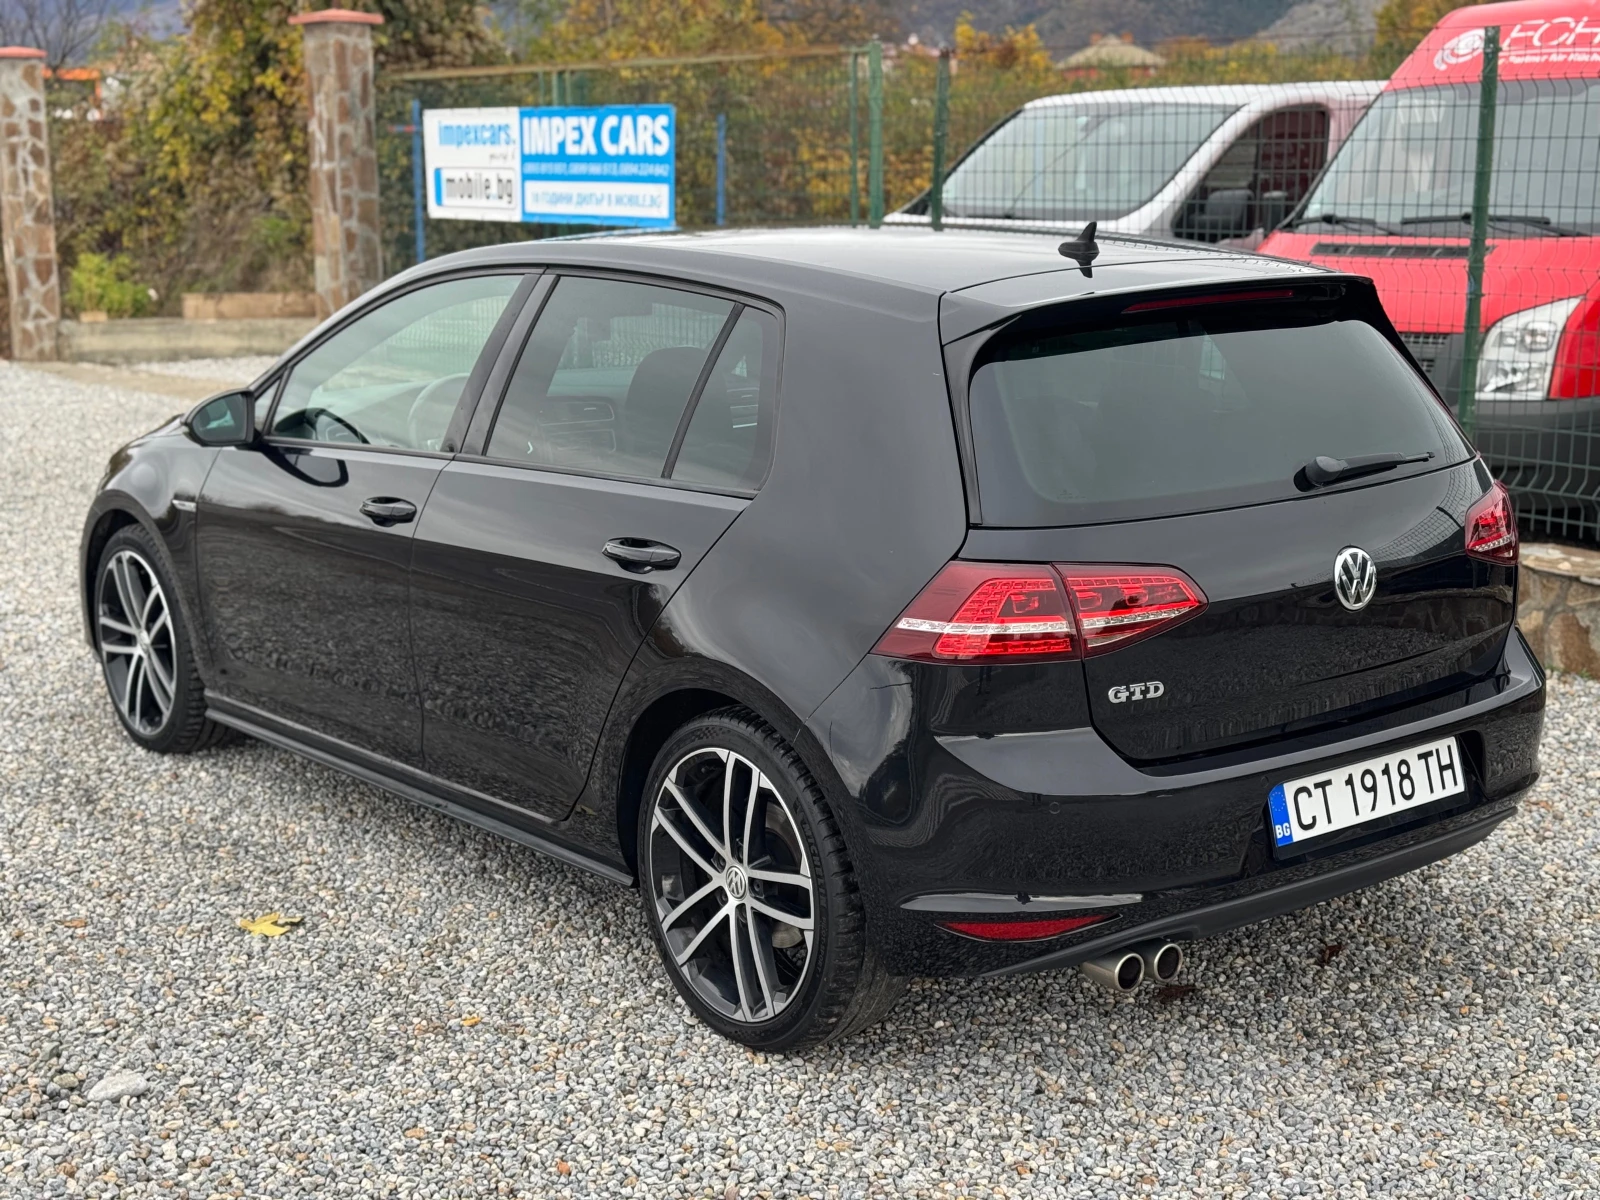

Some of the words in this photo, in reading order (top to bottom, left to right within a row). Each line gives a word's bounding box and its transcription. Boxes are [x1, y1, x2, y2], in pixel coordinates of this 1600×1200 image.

[522, 116, 598, 156] IMPEX
[600, 114, 670, 157] CARS
[446, 173, 513, 205] mobile.bg
[1108, 681, 1165, 704] GTD
[1293, 778, 1333, 831] CT
[1345, 759, 1416, 816] 1918
[1417, 744, 1459, 795] TH
[1275, 822, 1291, 839] BG
[802, 822, 827, 909] MICHELIN
